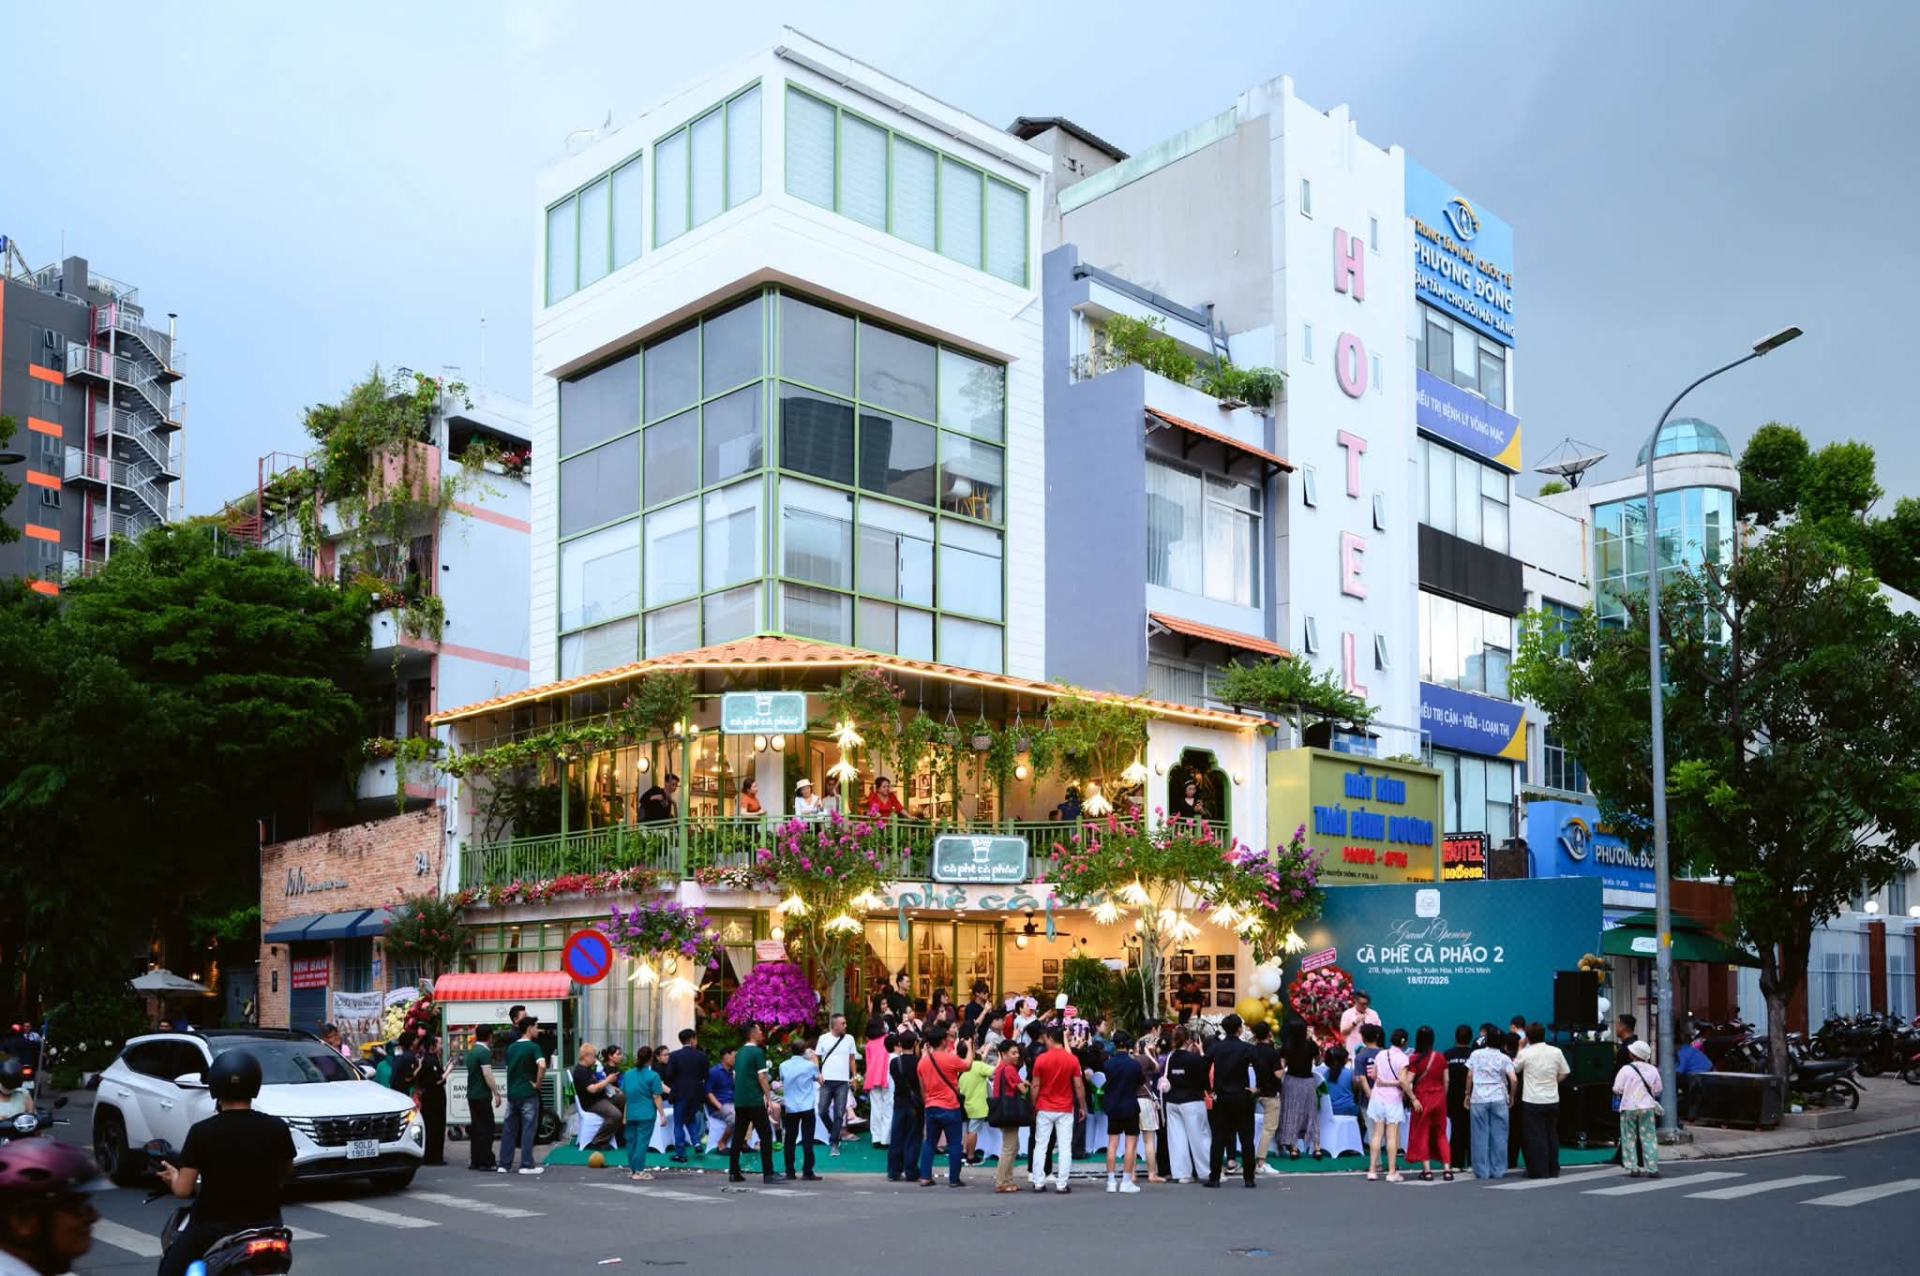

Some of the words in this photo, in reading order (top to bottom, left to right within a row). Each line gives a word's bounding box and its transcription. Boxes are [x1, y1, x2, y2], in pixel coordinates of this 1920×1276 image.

[1414, 240, 1471, 289] PHƯƠNG
[1475, 276, 1513, 314] ĐÔNG
[1446, 290, 1464, 310] CHO
[1334, 227, 1368, 699] HOTEL
[1386, 919, 1431, 945] Grand
[1430, 917, 1472, 942] Opening
[1357, 944, 1376, 963] CÀ
[1381, 944, 1412, 963] PHÊ
[1414, 943, 1434, 963] CÀ
[1440, 943, 1488, 963] PHÁO
[1493, 946, 1504, 963] 2
